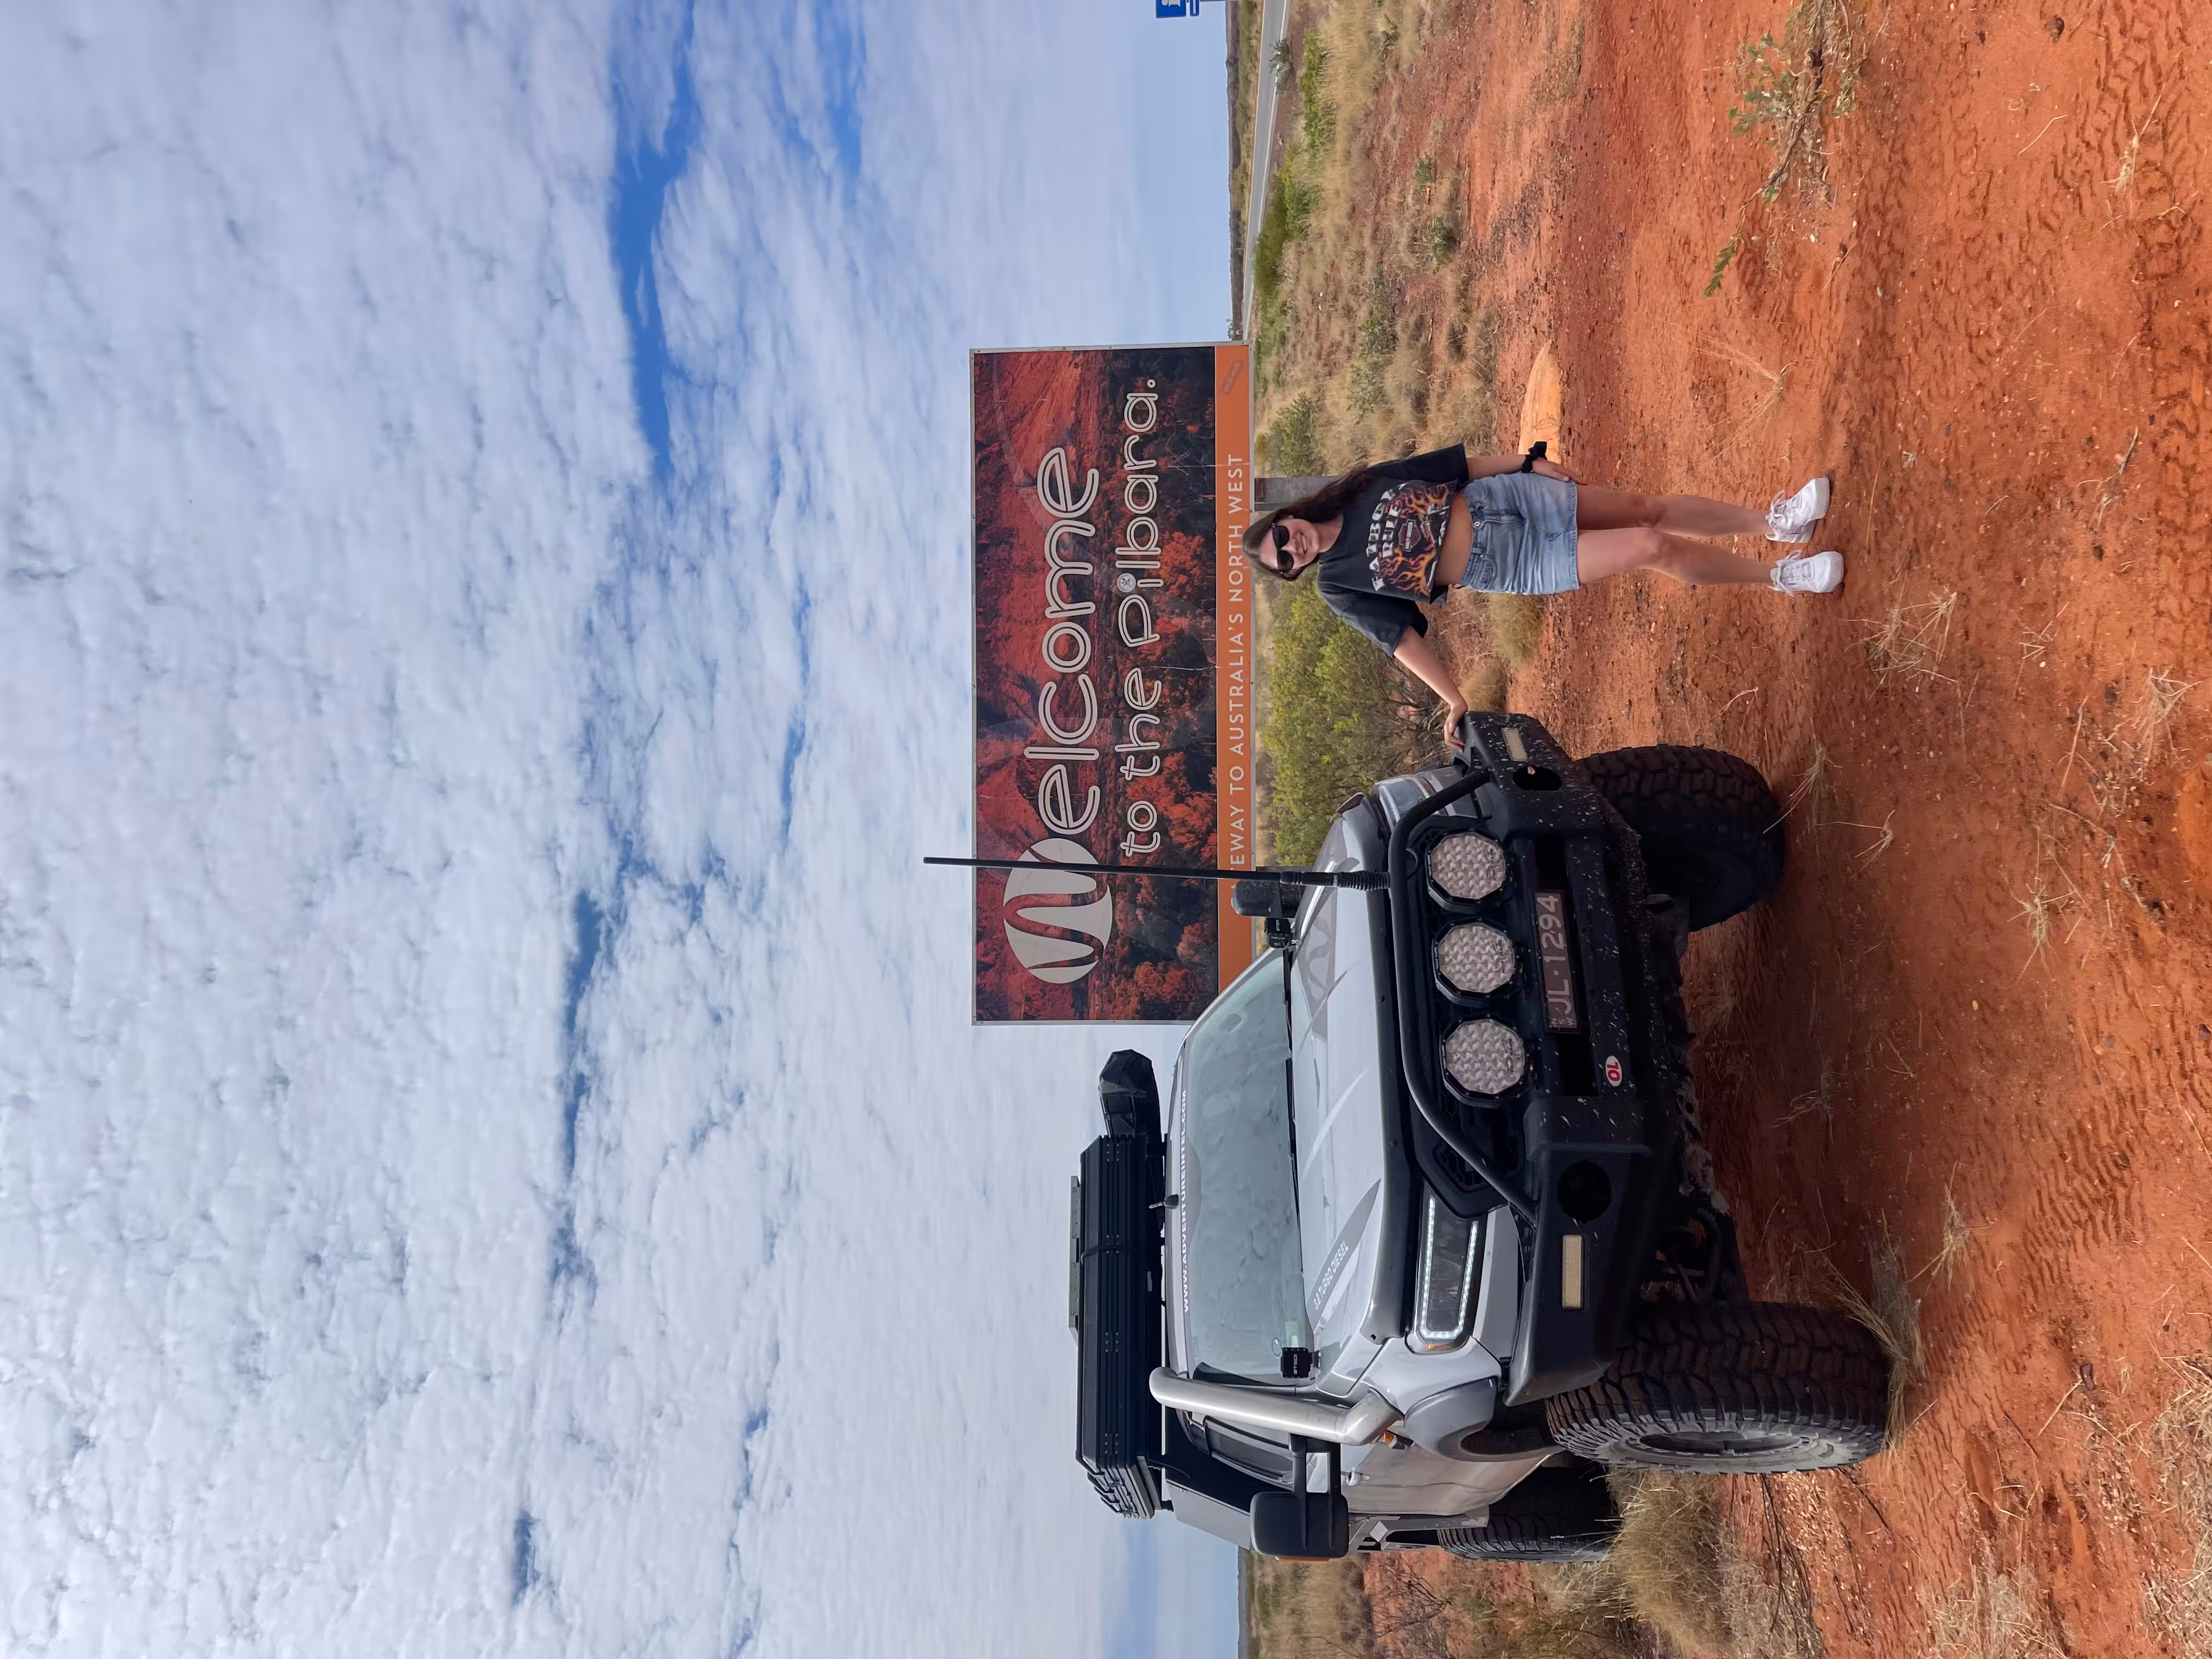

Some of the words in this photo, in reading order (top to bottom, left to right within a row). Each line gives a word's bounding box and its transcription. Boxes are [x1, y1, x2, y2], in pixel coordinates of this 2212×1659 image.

[1115, 380, 1163, 647] Pilbara.
[1228, 454, 1243, 514] WEST
[1228, 525, 1243, 601] NORTH
[1003, 448, 1113, 984] Welcome
[1115, 668, 1161, 780] the
[1228, 613, 1244, 756] AUSTRALIA'S
[1229, 765, 1244, 795] TO
[1120, 801, 1160, 856] to
[1181, 1090, 1189, 1313] WWW.ADVENTUREINTEL.COM
[1318, 1267, 1334, 1299] TURBO
[1330, 1240, 1348, 1274] DIESEL
